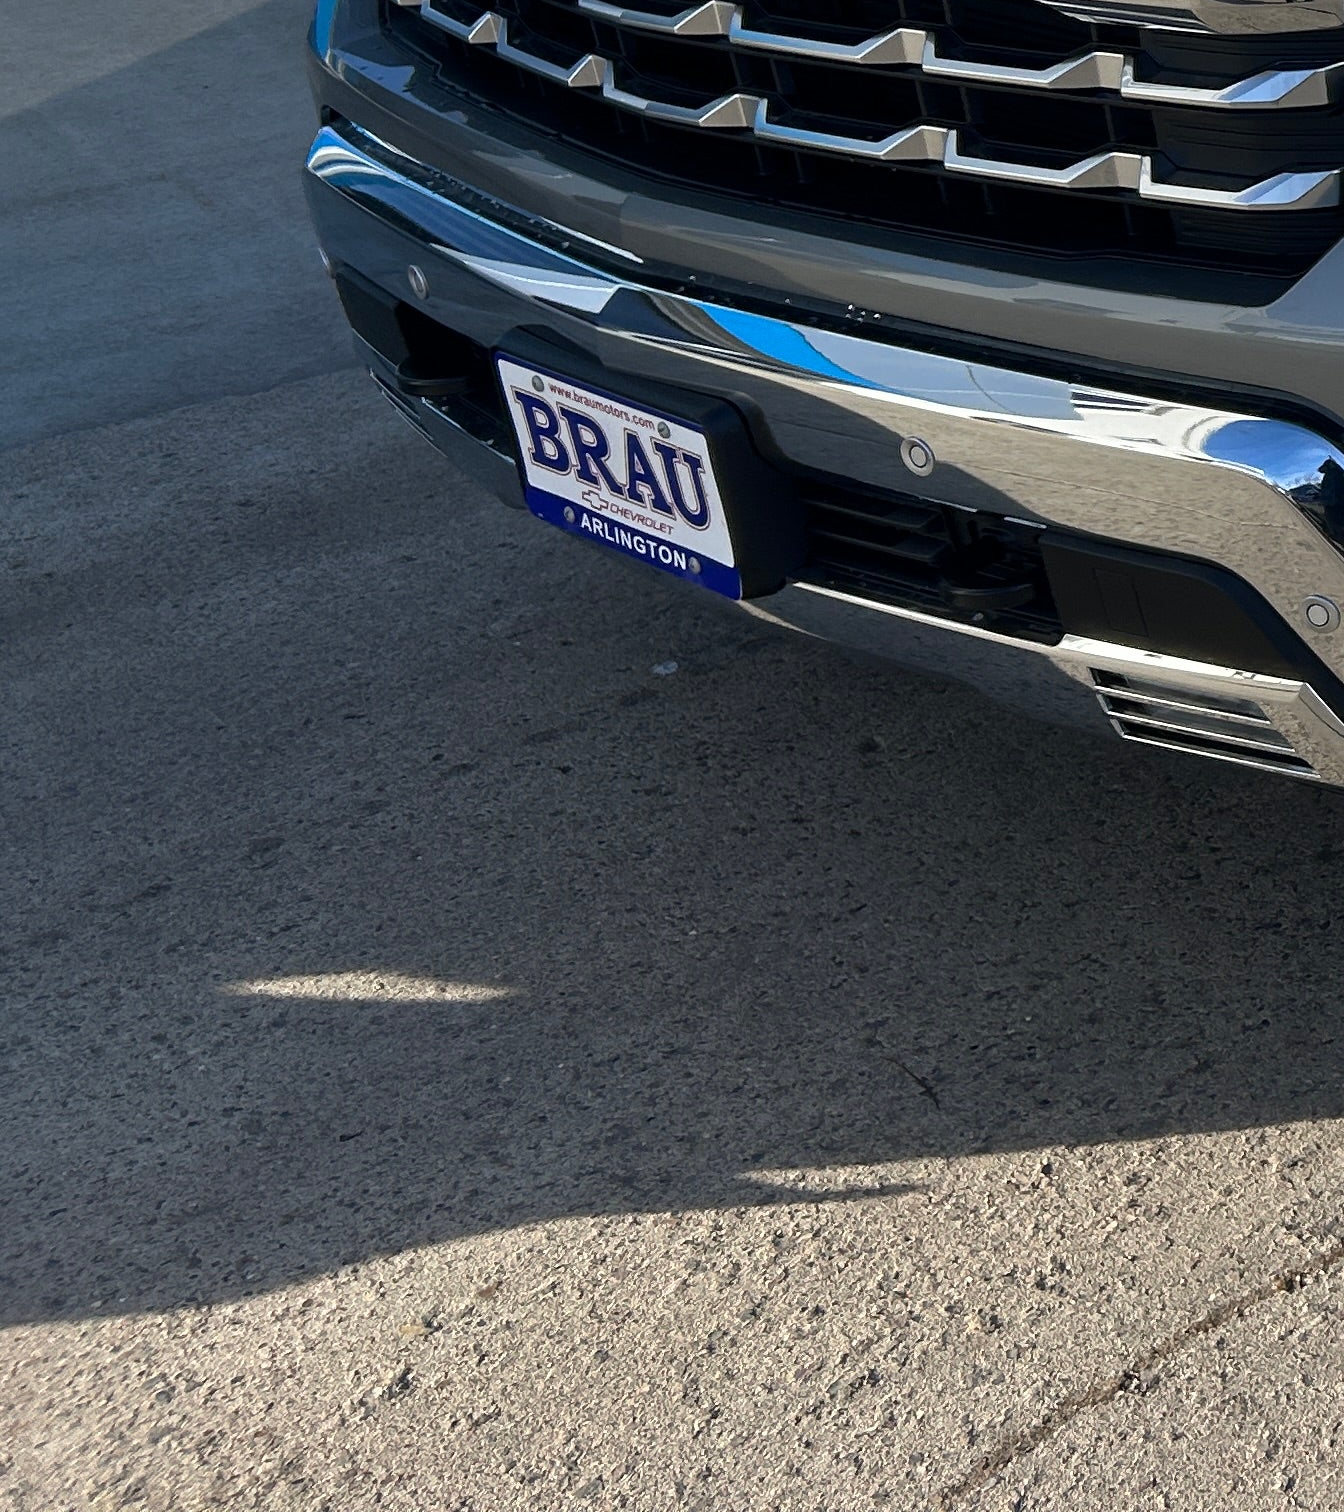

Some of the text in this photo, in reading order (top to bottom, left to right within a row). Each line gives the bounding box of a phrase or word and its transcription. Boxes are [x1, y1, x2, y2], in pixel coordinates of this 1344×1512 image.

[548, 382, 655, 431] www.braumotors.com
[511, 385, 711, 531] BRAU
[580, 512, 687, 571] ARLINGTON
[610, 502, 674, 535] CHEVROLET
